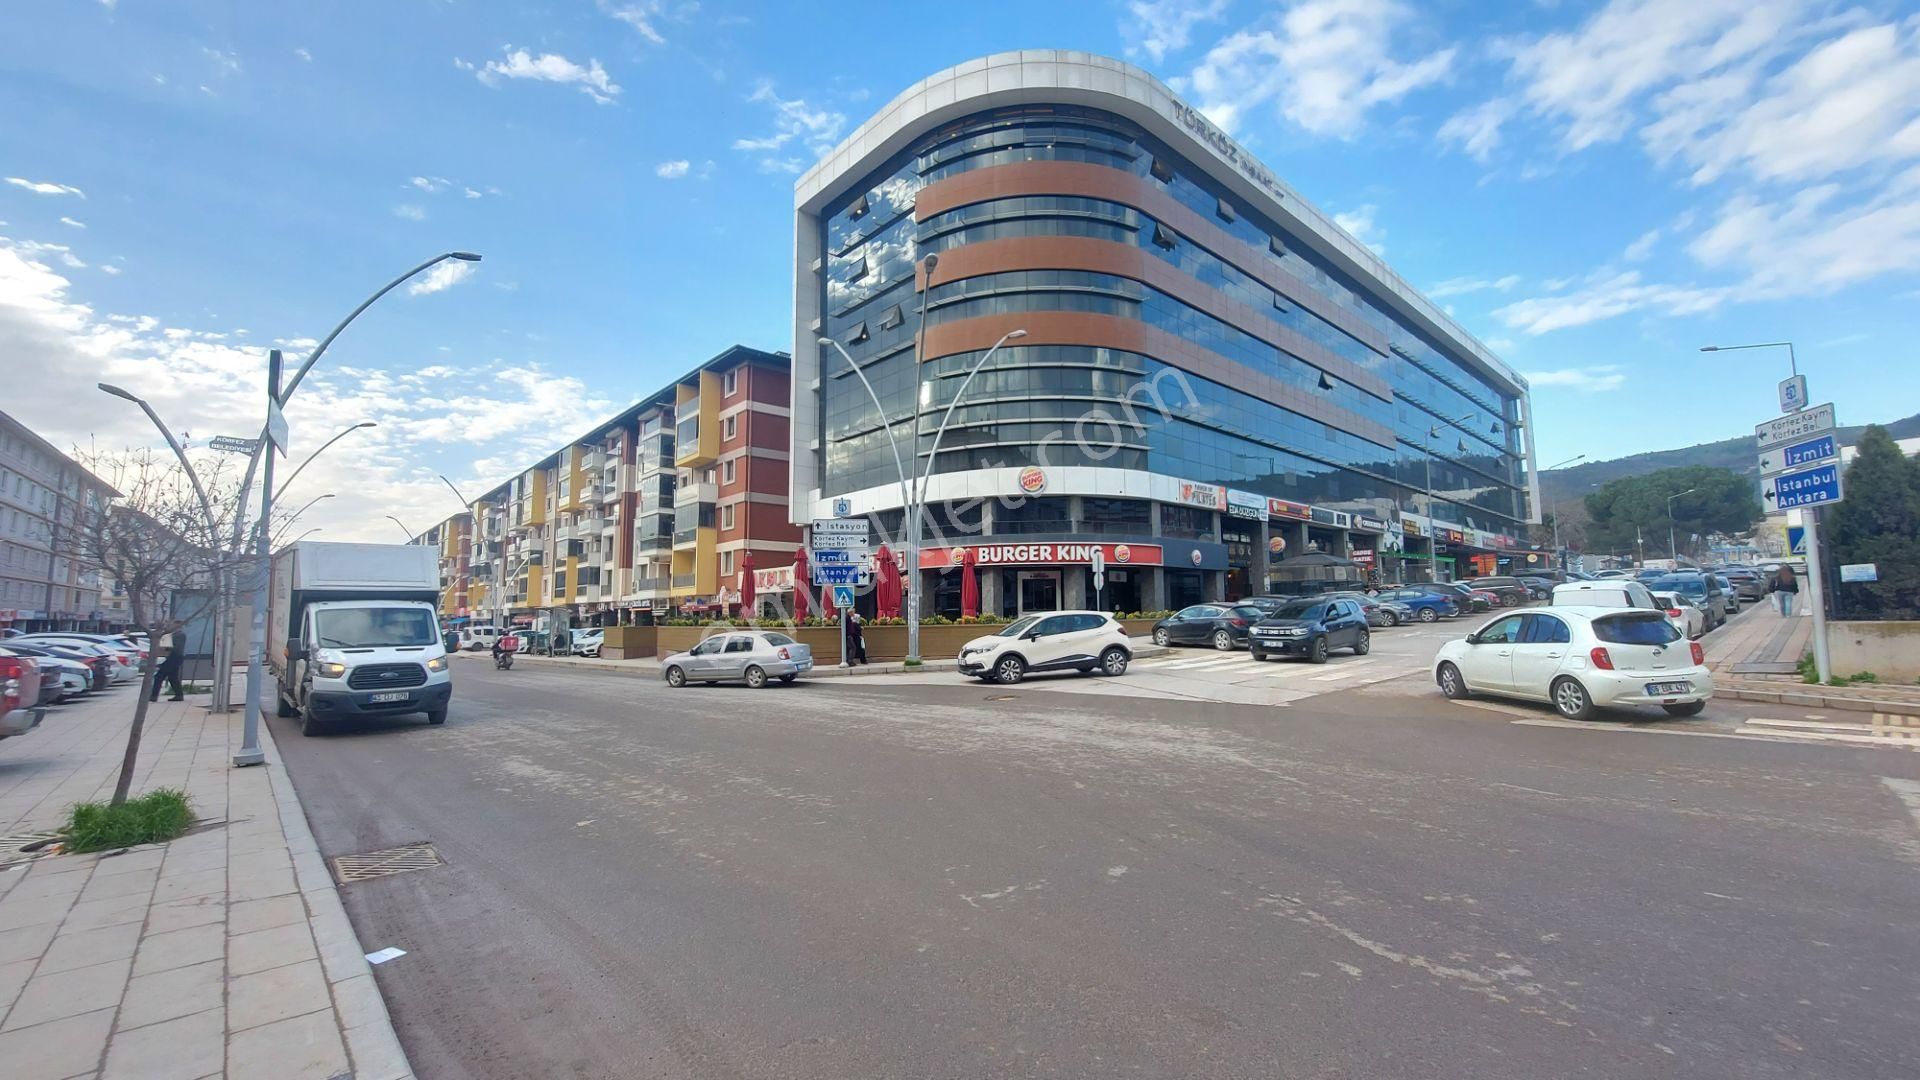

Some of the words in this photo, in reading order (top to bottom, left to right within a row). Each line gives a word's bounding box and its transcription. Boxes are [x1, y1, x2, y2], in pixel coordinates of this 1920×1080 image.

[1171, 99, 1238, 164] TÜRKÖZ
[1771, 417, 1800, 431] Körfez
[1772, 428, 1801, 441] Körfez
[1787, 442, 1832, 465] İzmit
[1777, 469, 1837, 493] İstanbul
[1778, 490, 1827, 508] Ankara
[826, 520, 868, 530] İstasyon
[978, 545, 1052, 563] BURGER
[1057, 545, 1103, 562] KING
[816, 566, 858, 576] İstanbul
